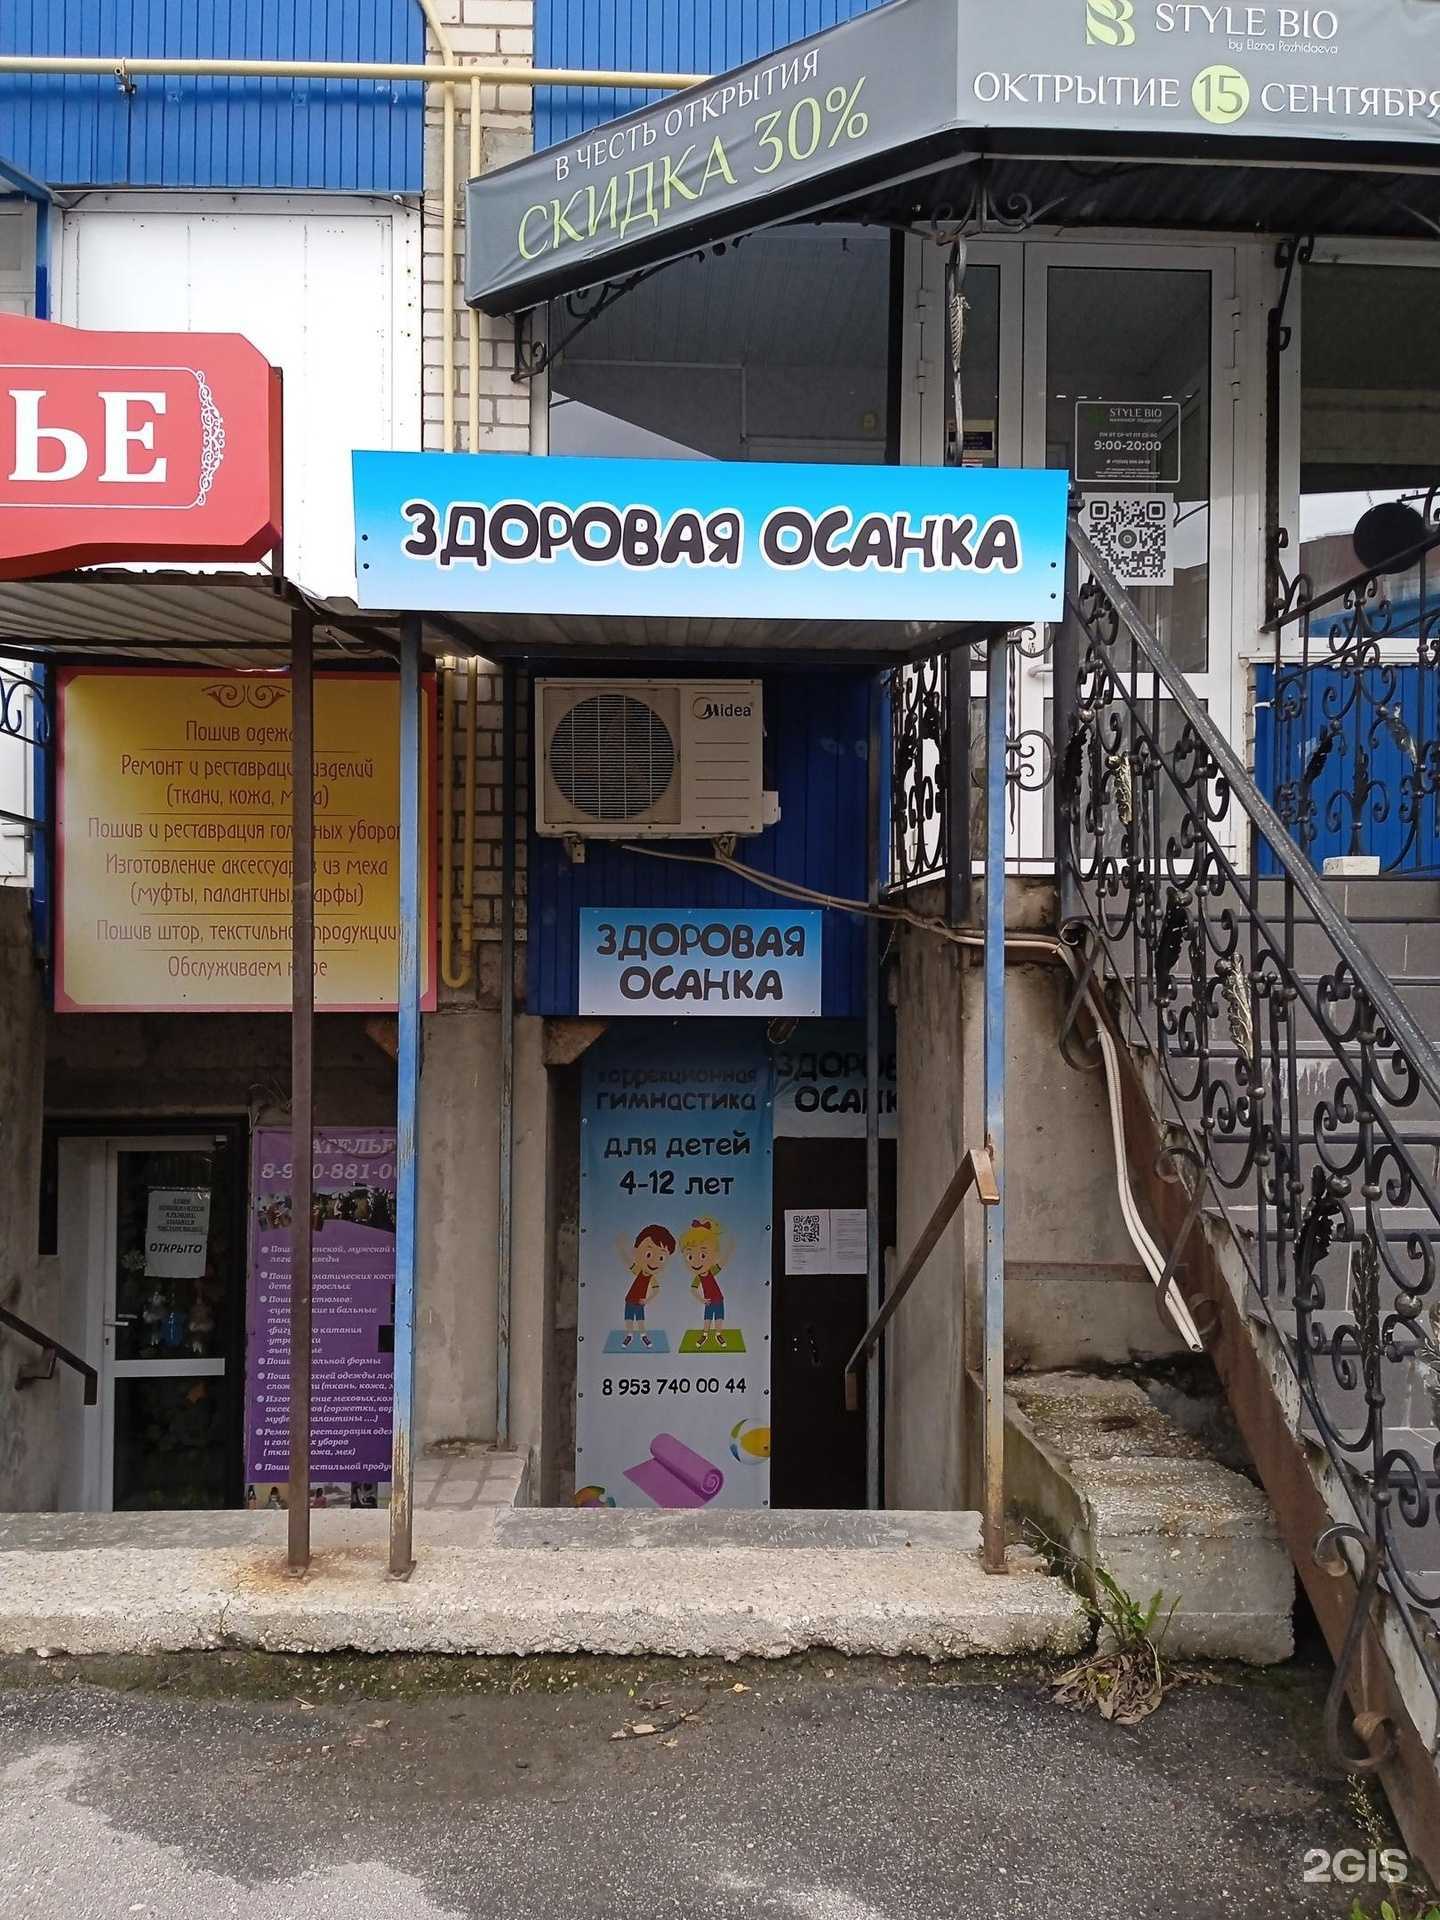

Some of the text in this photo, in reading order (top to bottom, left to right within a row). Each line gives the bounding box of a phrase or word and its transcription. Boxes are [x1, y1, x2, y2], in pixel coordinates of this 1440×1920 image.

[1155, 3, 1338, 39] STYLE BIO
[1228, 39, 1338, 54] by Elena Pozhidaeva
[973, 71, 1180, 108] ОКТРЫТИЕ
[1200, 74, 1243, 114] 15
[555, 47, 820, 182] В ЧЕСТЬ ОТКРЫТИЯ
[517, 76, 869, 261] СКИДКА 30%
[1109, 408, 1162, 418] STYLE BIO
[1094, 440, 1162, 451] 9:00-20:00
[402, 500, 1021, 572] ЗДОРОВАЯ ОСАНКА
[701, 702, 751, 718] Midea
[185, 720, 294, 746] Пошив одеж
[121, 755, 183, 777] Ремонт
[189, 761, 198, 776] и
[204, 760, 294, 780] реставраци
[166, 785, 329, 809] (ткани, кожа, ма)
[88, 817, 400, 843] Пошив и реставрация голных уборо
[106, 853, 216, 875] Изготовление
[323, 858, 340, 875] из
[346, 858, 388, 876] меха
[130, 881, 199, 907] (муфты,
[313, 881, 364, 907] арфы)
[96, 919, 151, 941] Пошив
[157, 923, 203, 943] штор,
[209, 923, 294, 941] текстильно
[596, 922, 806, 961] ЗДОРОВАЯ
[168, 956, 282, 980] Обслуживаем
[619, 965, 784, 1001] ОСАНКА
[604, 1129, 752, 1159] для детей
[619, 1170, 735, 1195] 4-12 лет
[150, 1242, 203, 1254] ОТКРЫТО
[602, 1377, 746, 1396] 8 953 740 00 44
